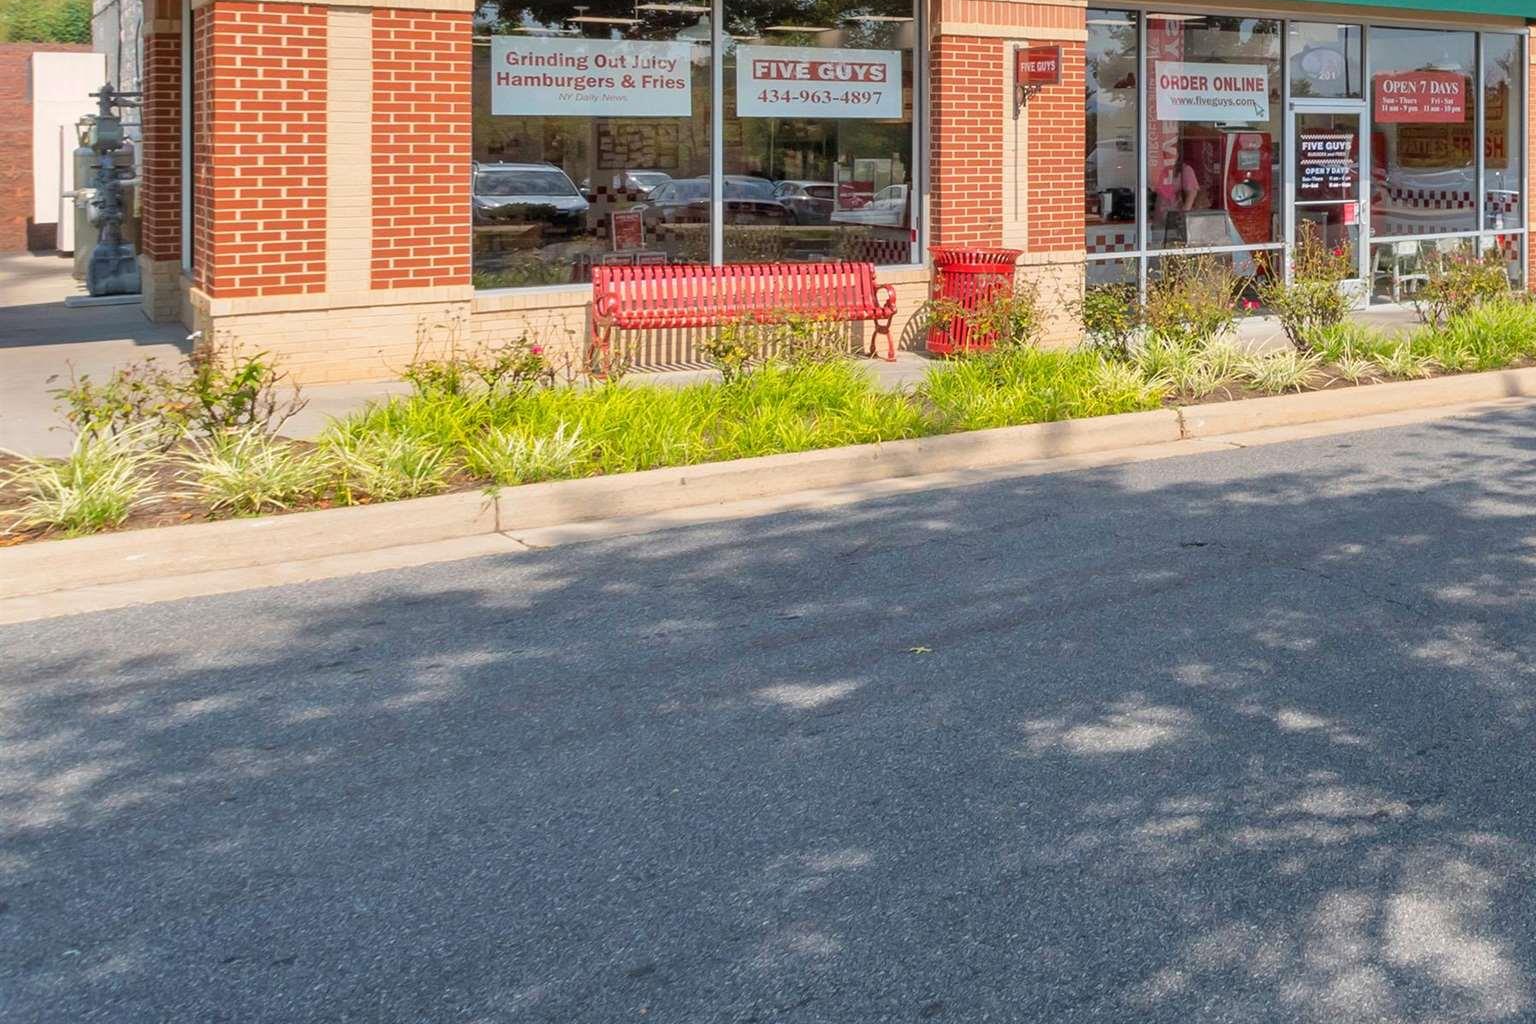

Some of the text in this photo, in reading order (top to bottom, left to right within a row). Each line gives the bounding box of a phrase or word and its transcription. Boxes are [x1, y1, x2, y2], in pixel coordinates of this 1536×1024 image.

[506, 51, 677, 73] Grinding Out Juicy
[1021, 60, 1056, 72] FIVE GUYS
[755, 62, 885, 81] FIVE GUYS
[496, 72, 686, 90] Hamburgers & Fries
[1160, 75, 1208, 91] ORDER
[1213, 76, 1265, 92] ONLINE
[1383, 79, 1459, 94] OPEN 7 DAYS
[558, 93, 573, 101] NY
[575, 93, 599, 103] Daily
[757, 89, 883, 105] 434-963-4897
[1170, 96, 1255, 107] www.fiveguys.com
[1302, 141, 1351, 151] FIVE GUYS
[1305, 167, 1325, 175] OPEN
